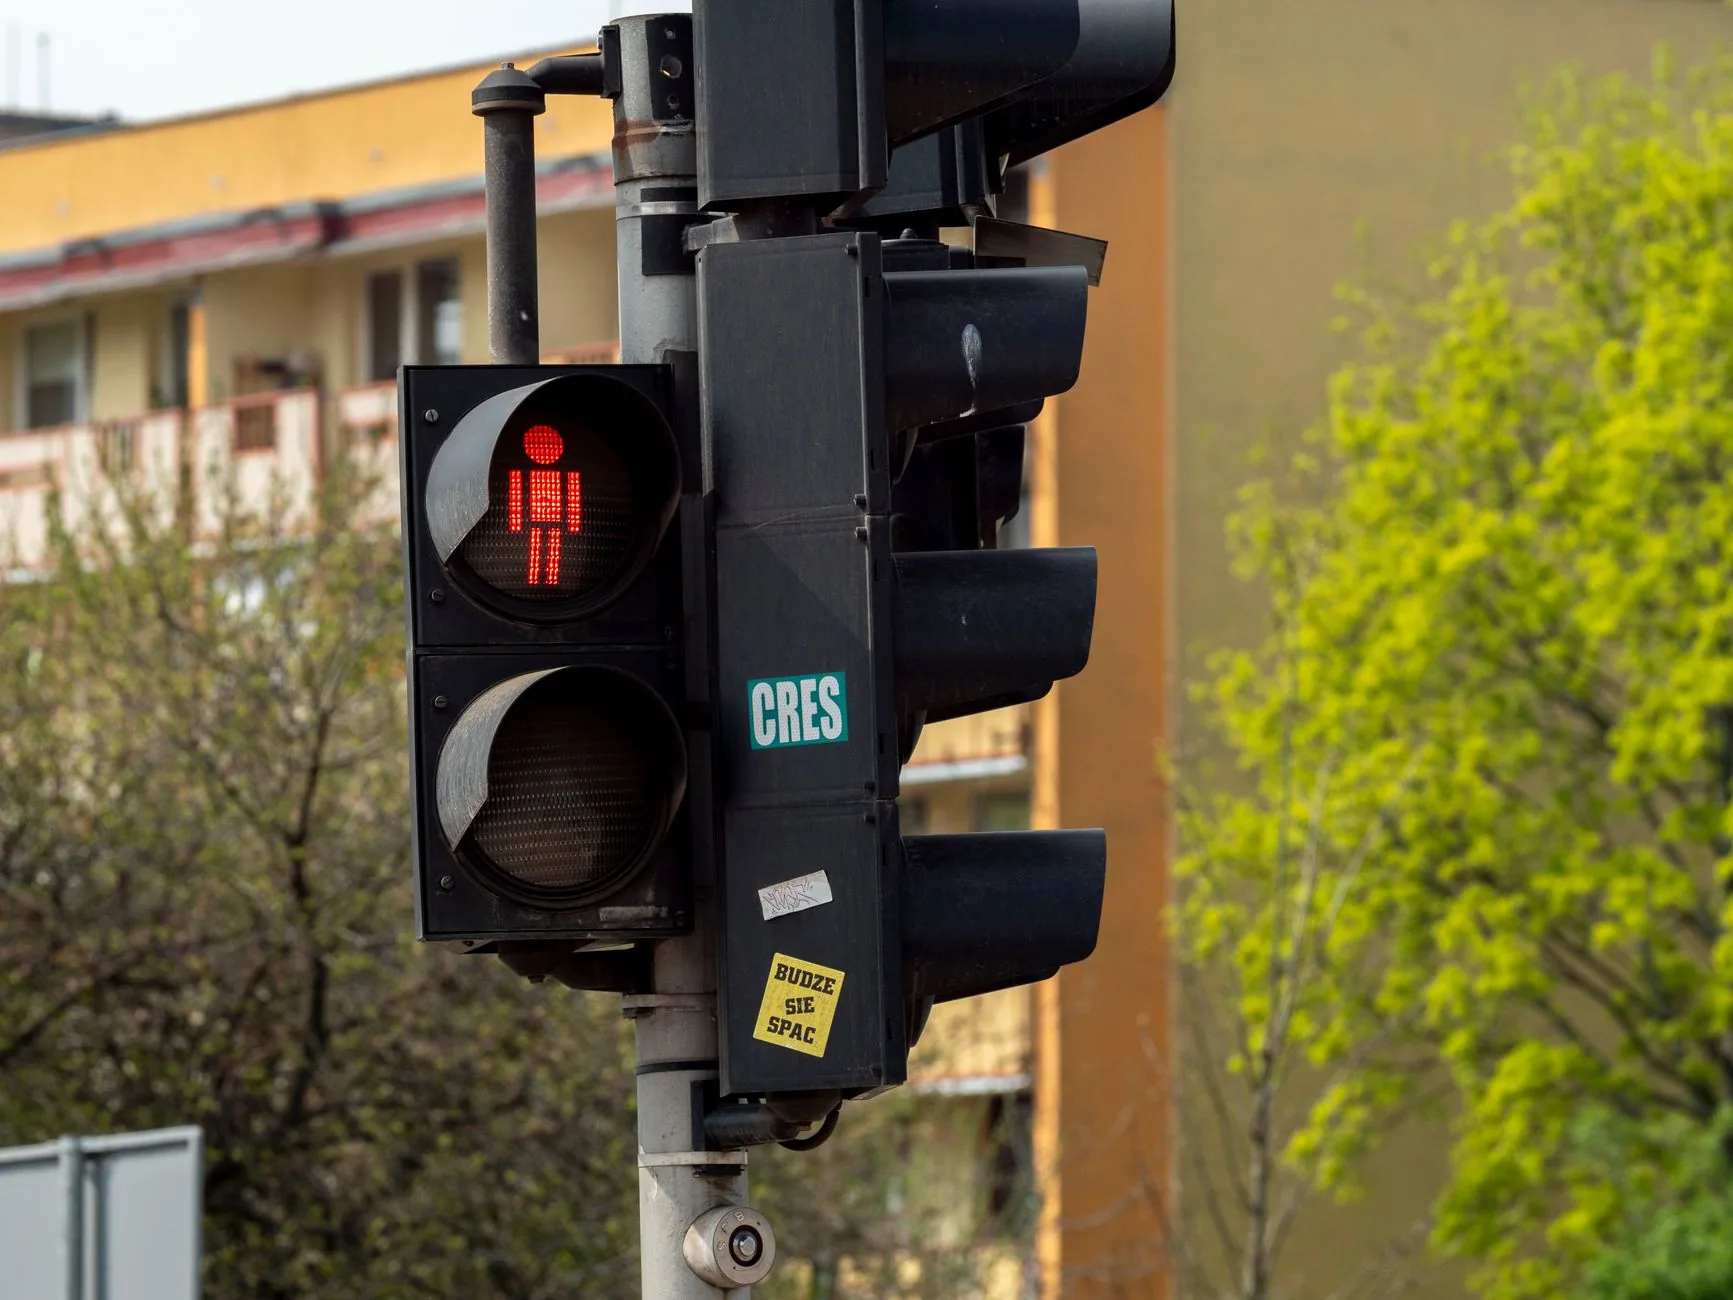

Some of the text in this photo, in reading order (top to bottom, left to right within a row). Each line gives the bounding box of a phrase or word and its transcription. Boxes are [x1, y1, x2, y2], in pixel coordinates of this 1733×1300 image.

[752, 675, 842, 746] CRES
[774, 963, 836, 995] BUDZE
[785, 996, 815, 1015] SIE
[766, 1016, 817, 1044] SPAC
